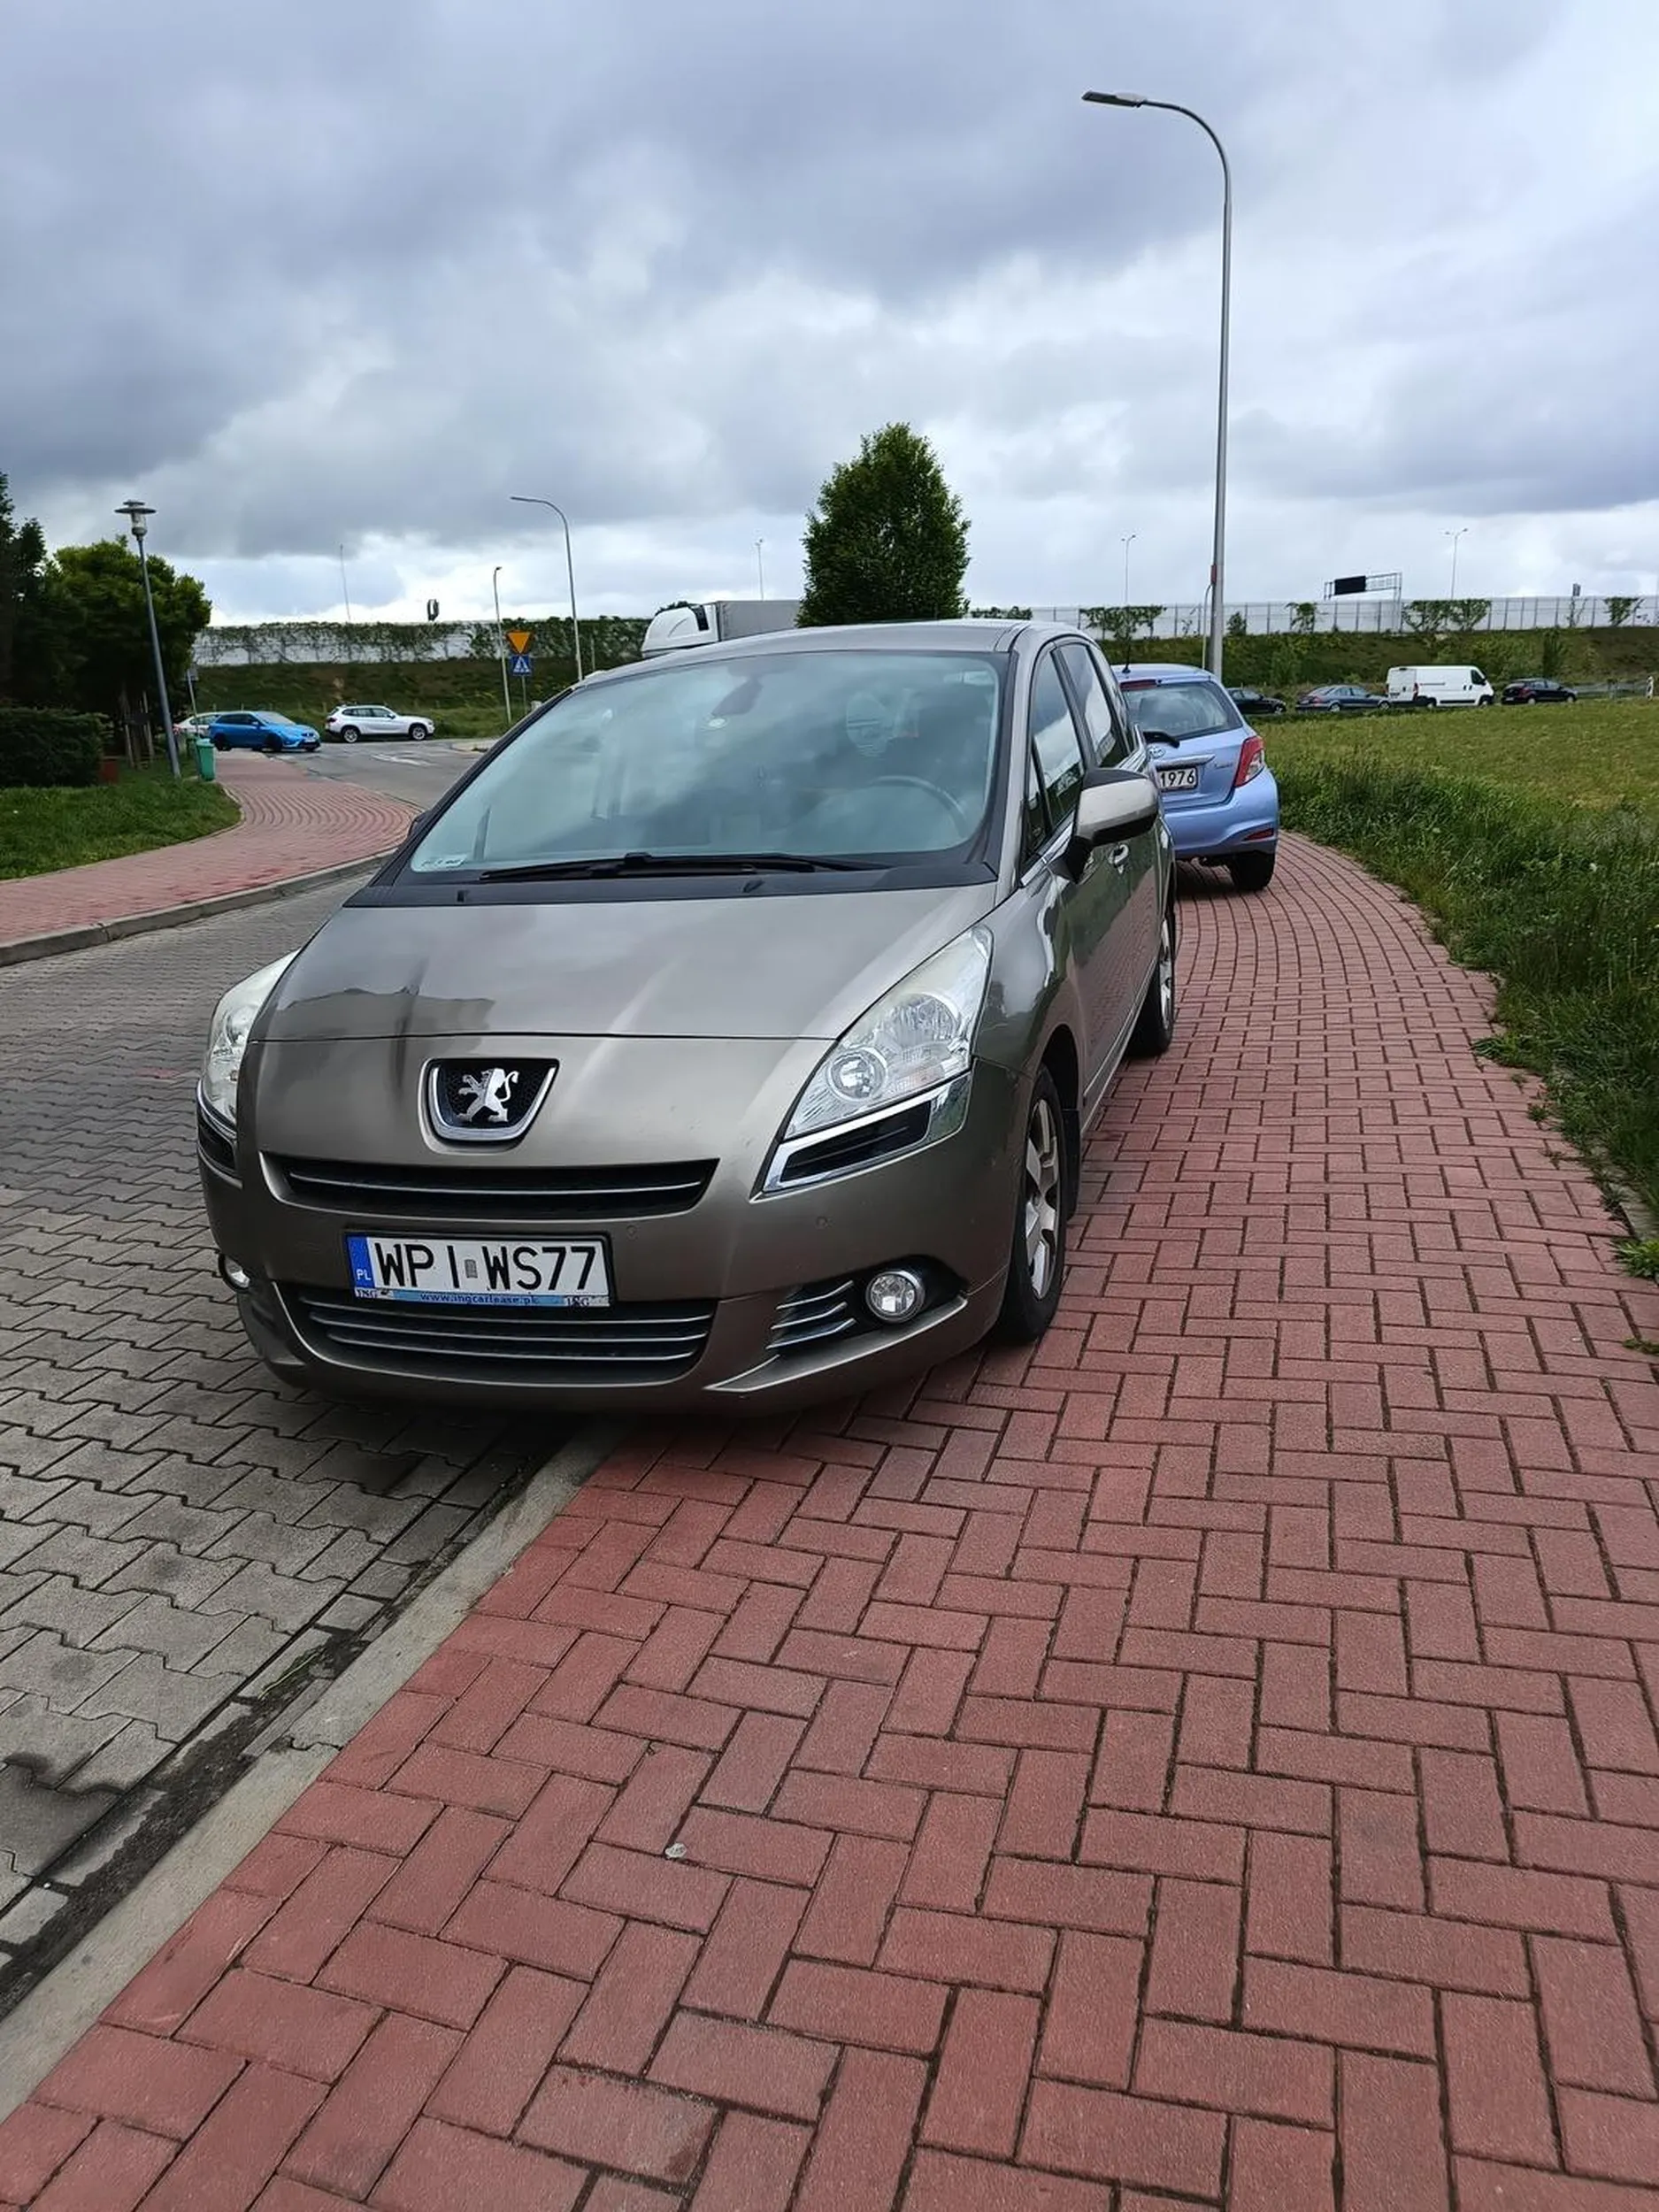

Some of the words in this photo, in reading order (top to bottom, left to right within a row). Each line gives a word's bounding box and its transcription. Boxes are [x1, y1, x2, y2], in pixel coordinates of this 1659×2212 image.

[1160, 770, 1194, 787] 1976
[356, 1269, 372, 1281] PL
[481, 1245, 596, 1291] WS77
